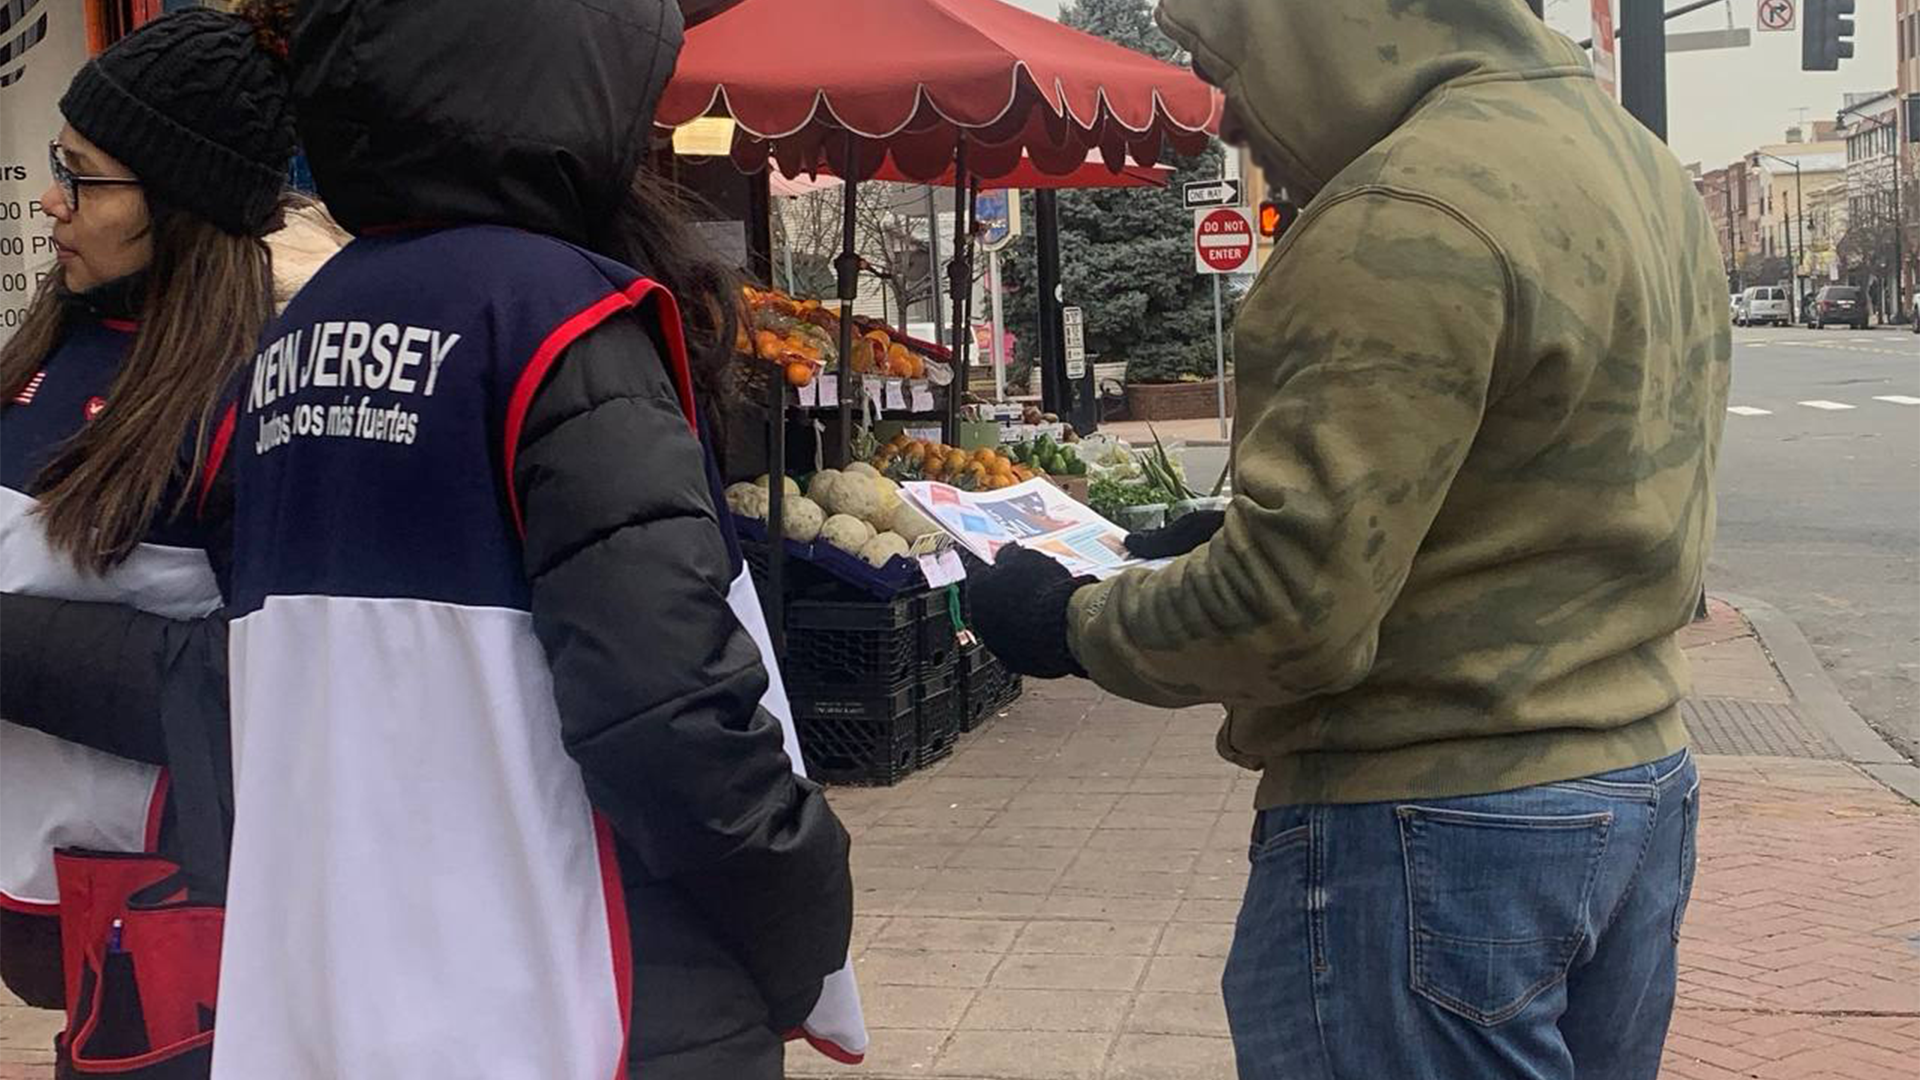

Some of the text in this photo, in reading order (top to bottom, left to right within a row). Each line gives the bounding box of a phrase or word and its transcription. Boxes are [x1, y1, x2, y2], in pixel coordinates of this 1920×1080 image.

[0, 165, 27, 181] rs
[1190, 189, 1222, 200] ONE WAY
[29, 200, 44, 219] P
[1204, 220, 1244, 232] DO NOT
[1209, 248, 1242, 260] ENTER
[247, 321, 461, 413] NEW JERSEY
[354, 396, 418, 445] fuertes
